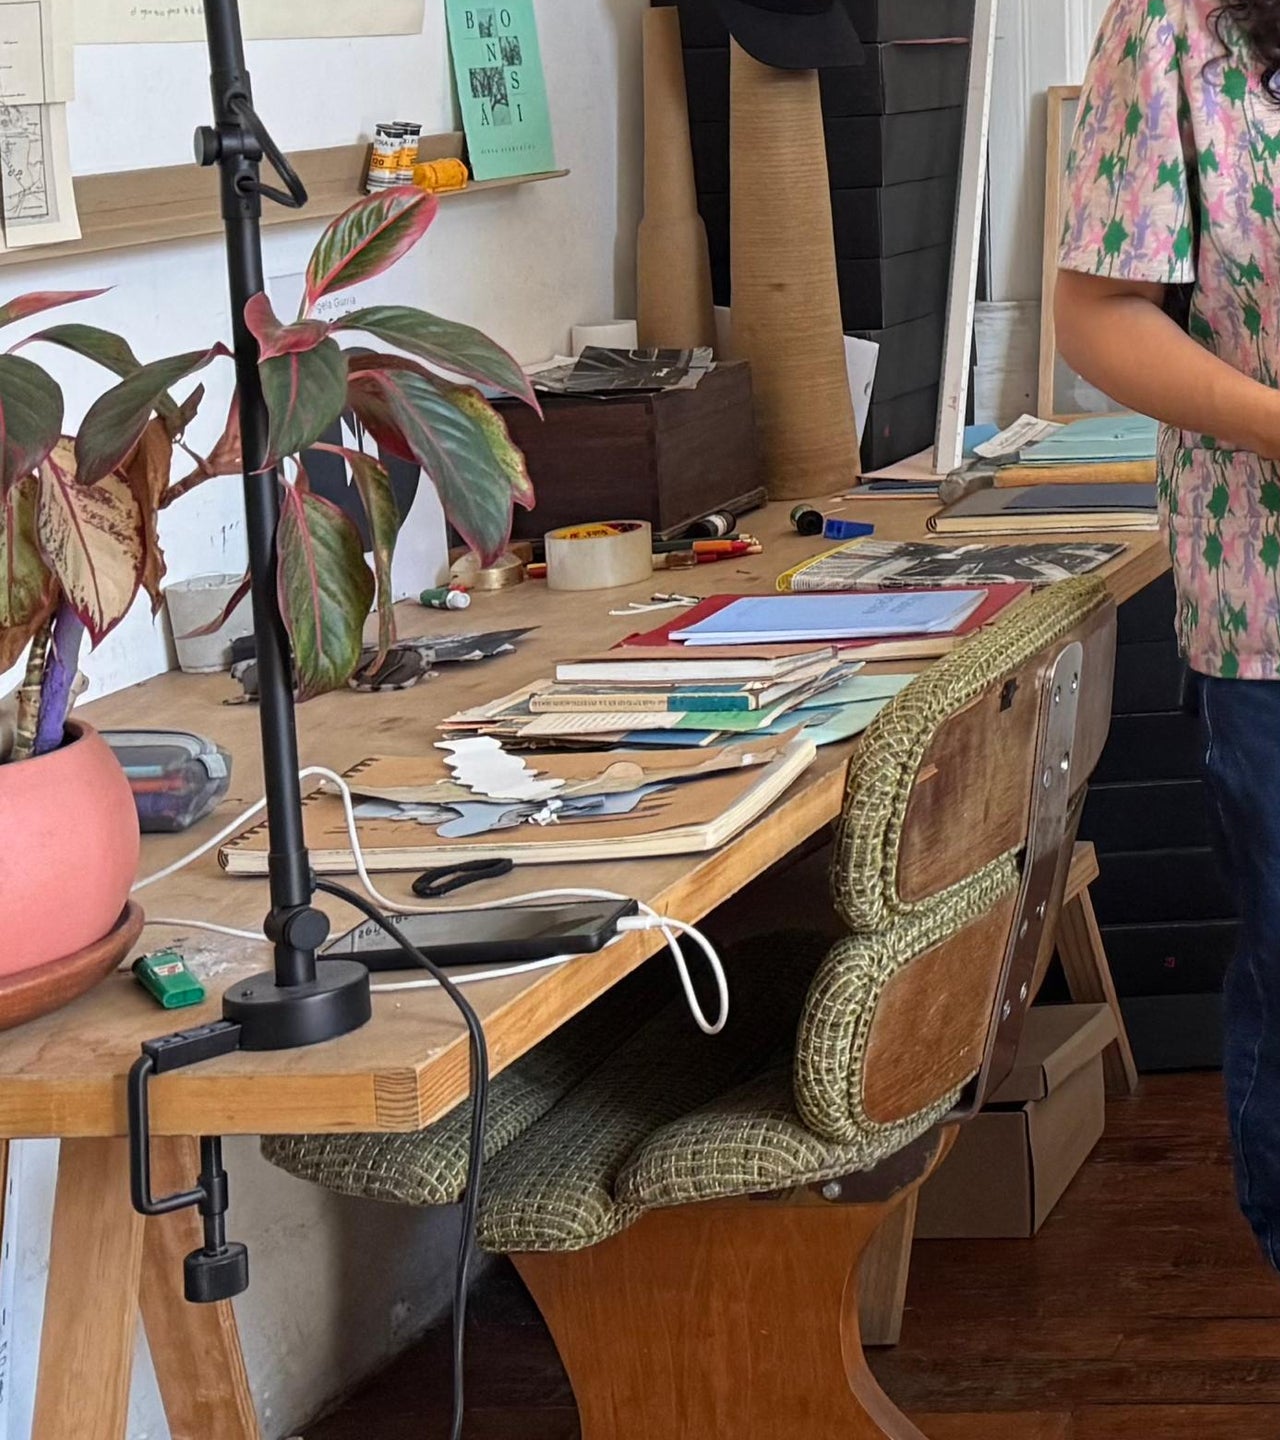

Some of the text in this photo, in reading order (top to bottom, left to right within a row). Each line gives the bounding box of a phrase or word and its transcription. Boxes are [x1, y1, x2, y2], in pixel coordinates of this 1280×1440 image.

[465, 9, 511, 30] B O
[486, 42, 498, 63] N
[511, 70, 521, 90] S
[517, 103, 524, 123] I
